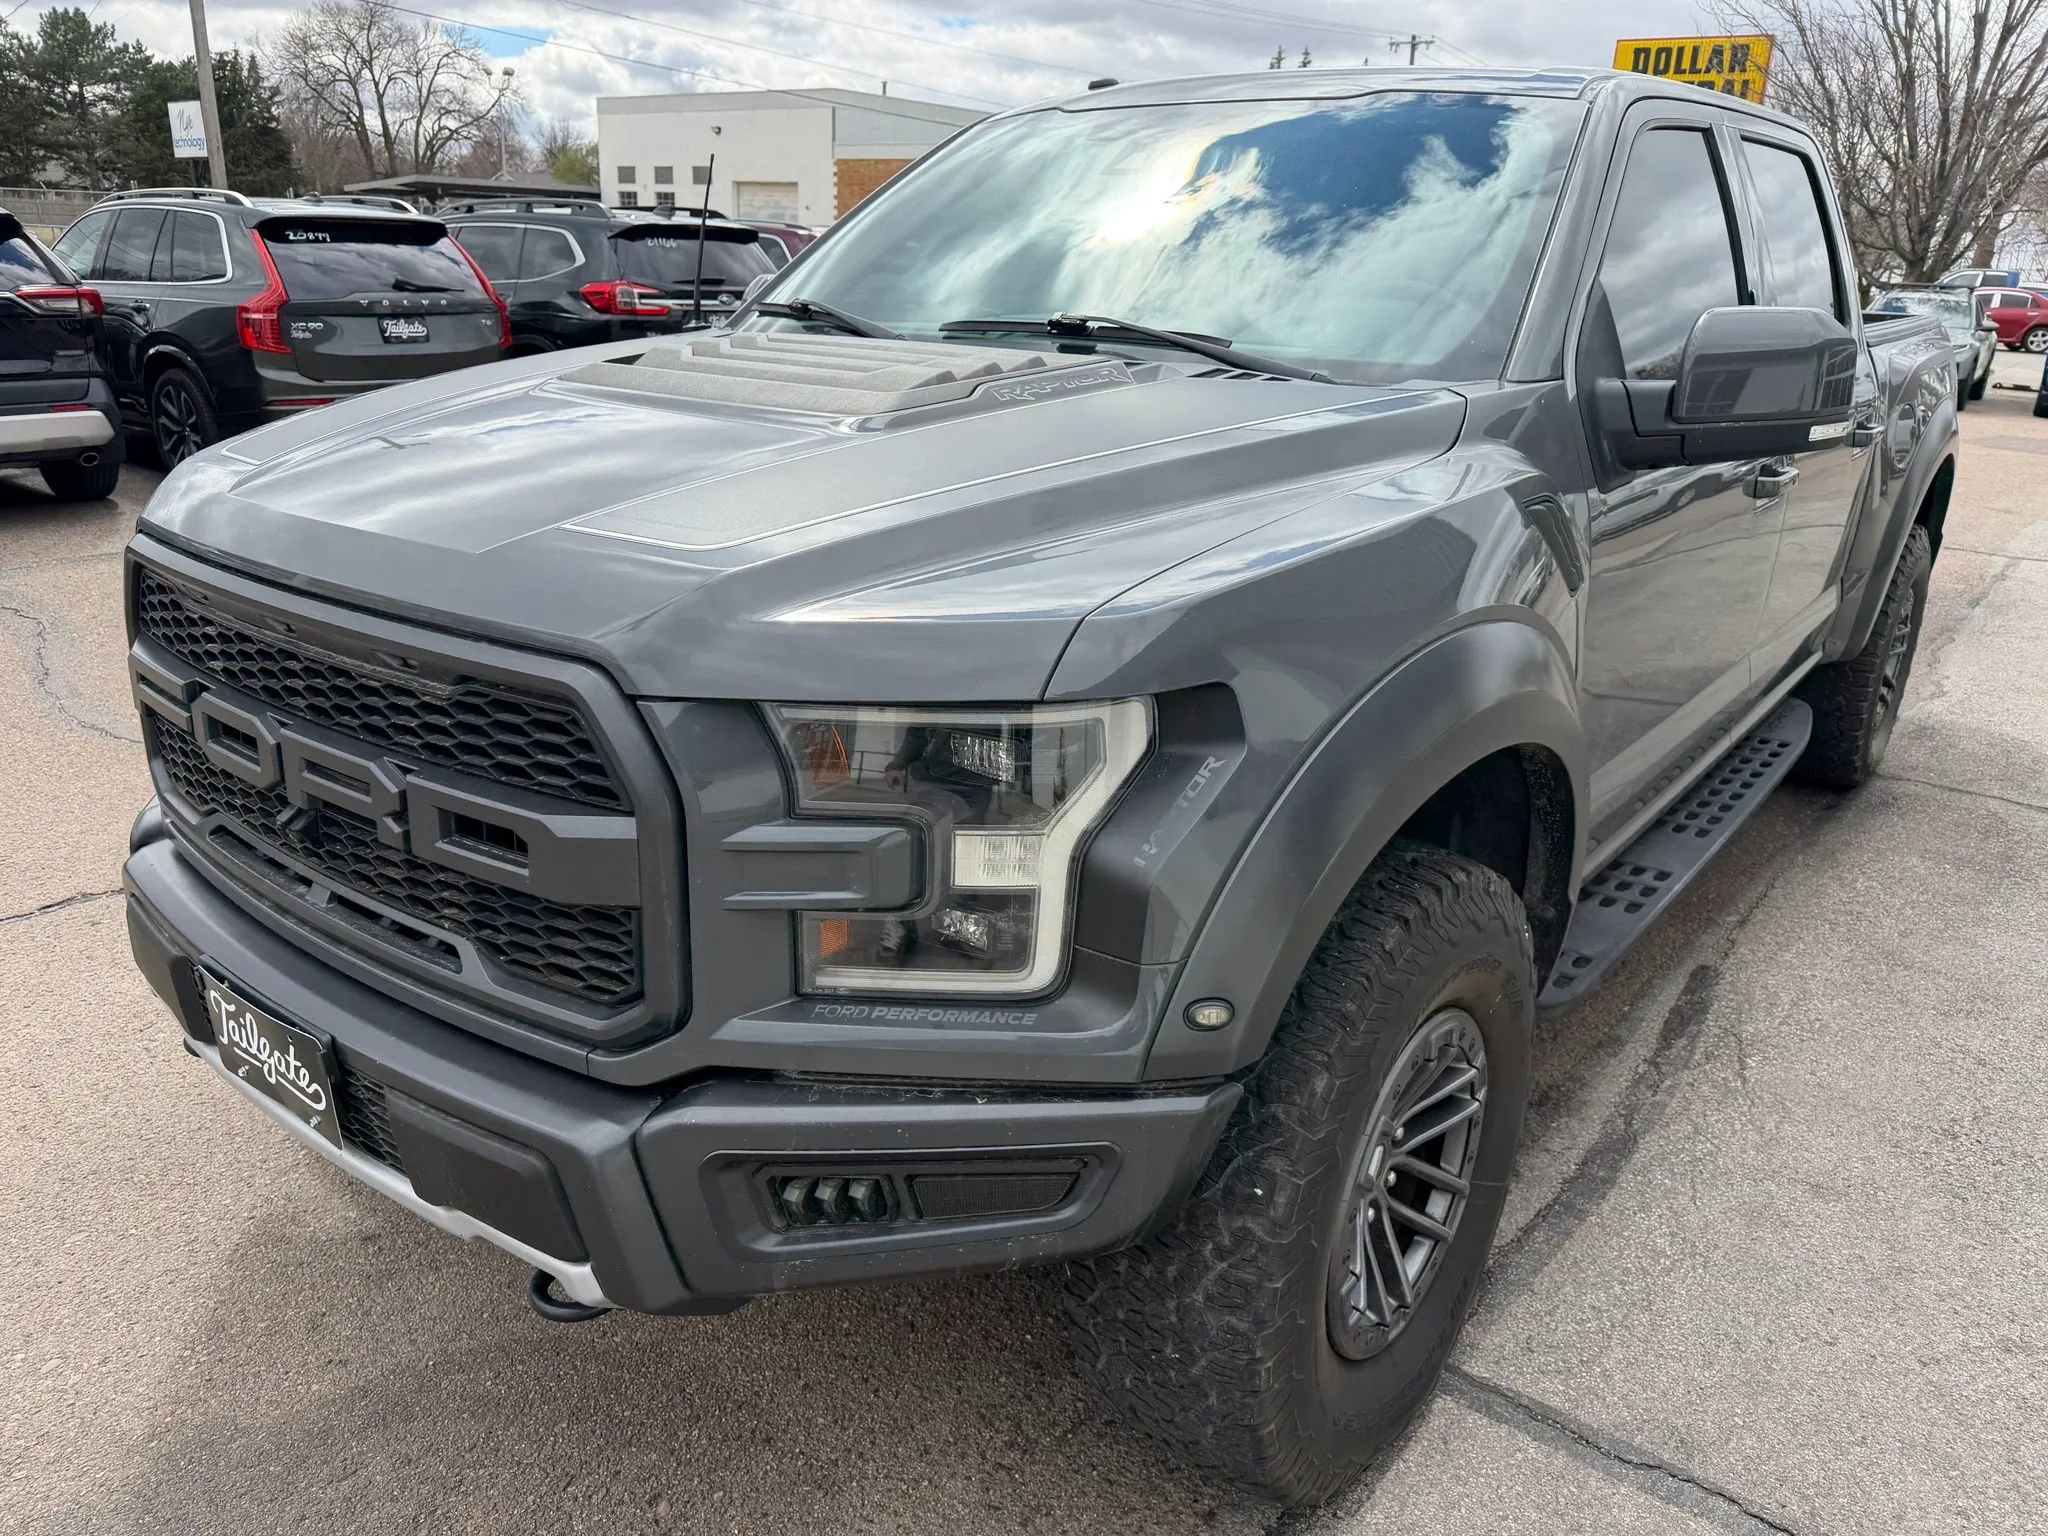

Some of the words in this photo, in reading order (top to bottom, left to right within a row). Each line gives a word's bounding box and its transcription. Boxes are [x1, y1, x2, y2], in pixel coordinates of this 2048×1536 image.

[1632, 43, 1750, 76] DOLLAR
[383, 318, 428, 339] Tailgate
[989, 367, 1132, 401] RAPTOR
[128, 646, 572, 895] FORD
[810, 1004, 869, 1018] FORD
[870, 1006, 1038, 1026] PERFORMANCE
[209, 989, 327, 1111] Tailgate
